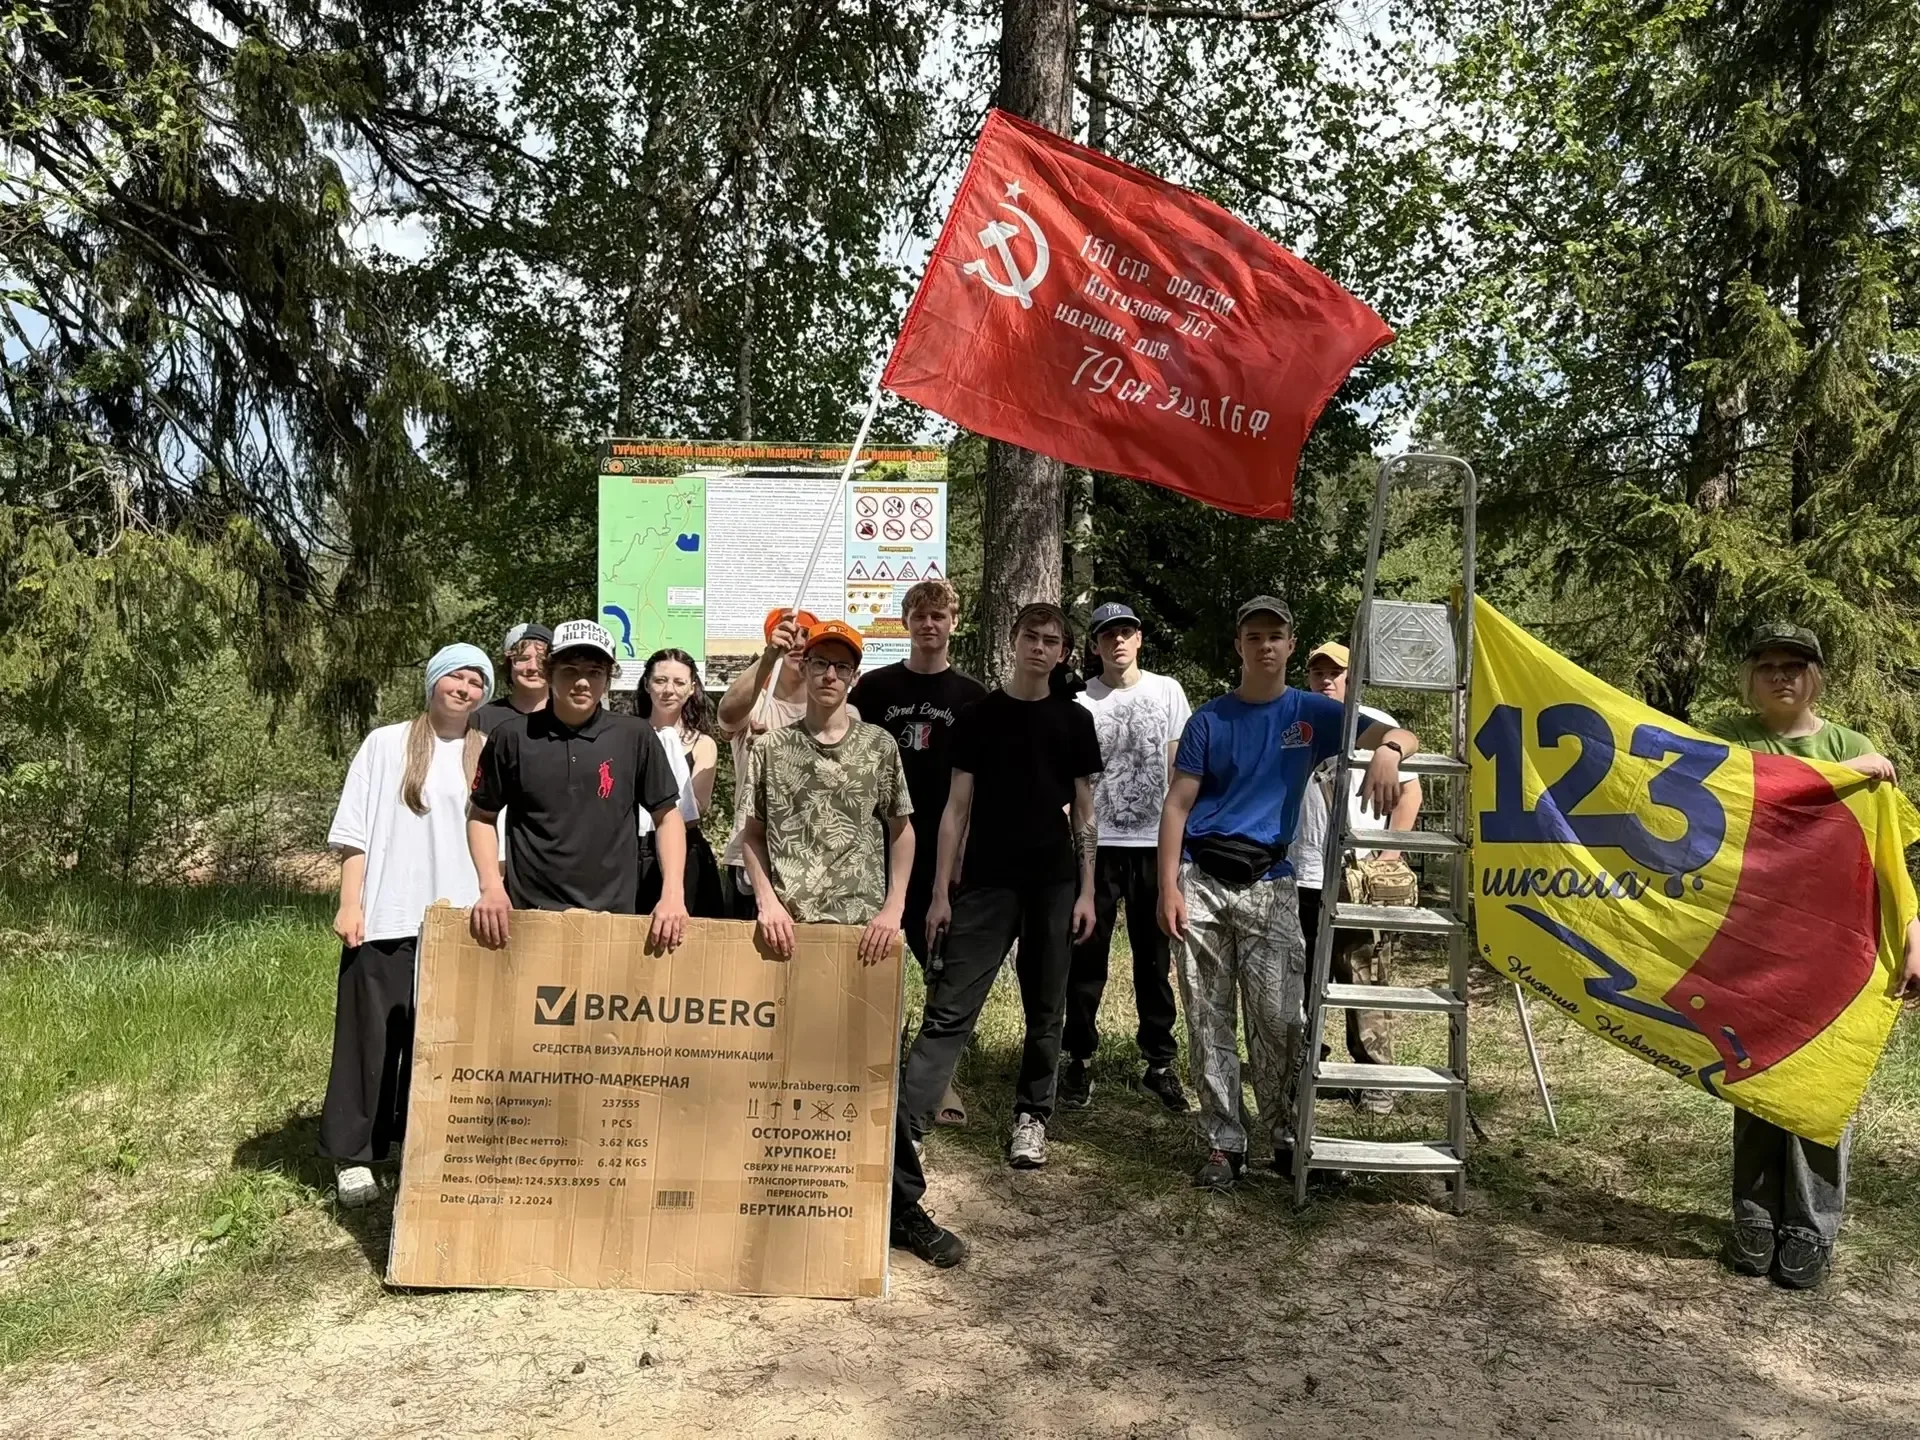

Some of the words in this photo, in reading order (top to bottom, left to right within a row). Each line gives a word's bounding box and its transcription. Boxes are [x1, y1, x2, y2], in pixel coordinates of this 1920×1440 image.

[1080, 234, 1116, 269] 150
[1118, 256, 1150, 287] СТР.
[1166, 275, 1236, 317] ОРДЕНА
[1071, 345, 1124, 394] 79
[612, 444, 693, 457] ТУРИСТИЧЕСКИЙ
[695, 446, 765, 458] ПЕШЕХОДНЫЙ
[766, 447, 814, 460] МАРШРУТ
[815, 448, 871, 461] "ЭКОТРПА
[563, 622, 608, 638] TOMMY
[562, 631, 610, 648] HILFIGER
[884, 703, 916, 722] Street
[919, 702, 955, 727] Loyalty
[1474, 703, 1729, 876] 123
[1481, 867, 1651, 900] школа
[584, 994, 776, 1028] BRAUBERG
[532, 1043, 592, 1056] СРЕДСТВА
[594, 1043, 672, 1058] ВИЗУАЛЬНОЙ
[674, 1047, 774, 1062] КОММУНИКАЦИИ
[451, 1067, 505, 1083] ДОСКА
[508, 1071, 690, 1090] МАГНИТНО-МАРКЕРНАЯ
[749, 1080, 860, 1093] www.brauberg.com
[449, 1095, 474, 1105] Item
[475, 1095, 494, 1105] No.
[495, 1096, 552, 1108] (Артикул):
[602, 1099, 640, 1109] 237555
[448, 1114, 494, 1127] Quantity
[496, 1115, 531, 1127] (К-во):
[601, 1119, 606, 1128] 1
[611, 1119, 632, 1128] PCS
[446, 1134, 465, 1144] Net
[466, 1134, 504, 1147] Weight
[506, 1136, 529, 1146] (Вес
[530, 1137, 568, 1147] нетто):
[599, 1138, 622, 1148] 3.62
[627, 1138, 648, 1148] KGS
[752, 1127, 851, 1142] ОСТОРОЖНО!
[764, 1146, 836, 1160] ХРУПКОЕ!
[444, 1154, 473, 1164] Gross
[475, 1154, 513, 1167] Weight
[515, 1155, 538, 1166] (Вес
[539, 1155, 584, 1168] брутто):
[597, 1158, 622, 1167] 6.42
[625, 1158, 647, 1167] KGS
[744, 1162, 779, 1173] СВЕРХУ
[781, 1164, 793, 1172] НЕ
[795, 1165, 855, 1175] НАГРУЖАТЬ!
[442, 1174, 472, 1184] Meas.
[525, 1176, 600, 1187] 124.5X3.8X95
[609, 1178, 626, 1187] CM
[747, 1176, 849, 1189] ТРАНСПОРТИРОВАТЬ,
[440, 1194, 466, 1204] Date
[467, 1194, 503, 1205] (Дата):
[509, 1196, 553, 1205] 12.2024
[766, 1189, 828, 1199] ПЕРЕНОСИТЬ
[739, 1203, 853, 1218] ВЕРТИКАЛЬНО!
